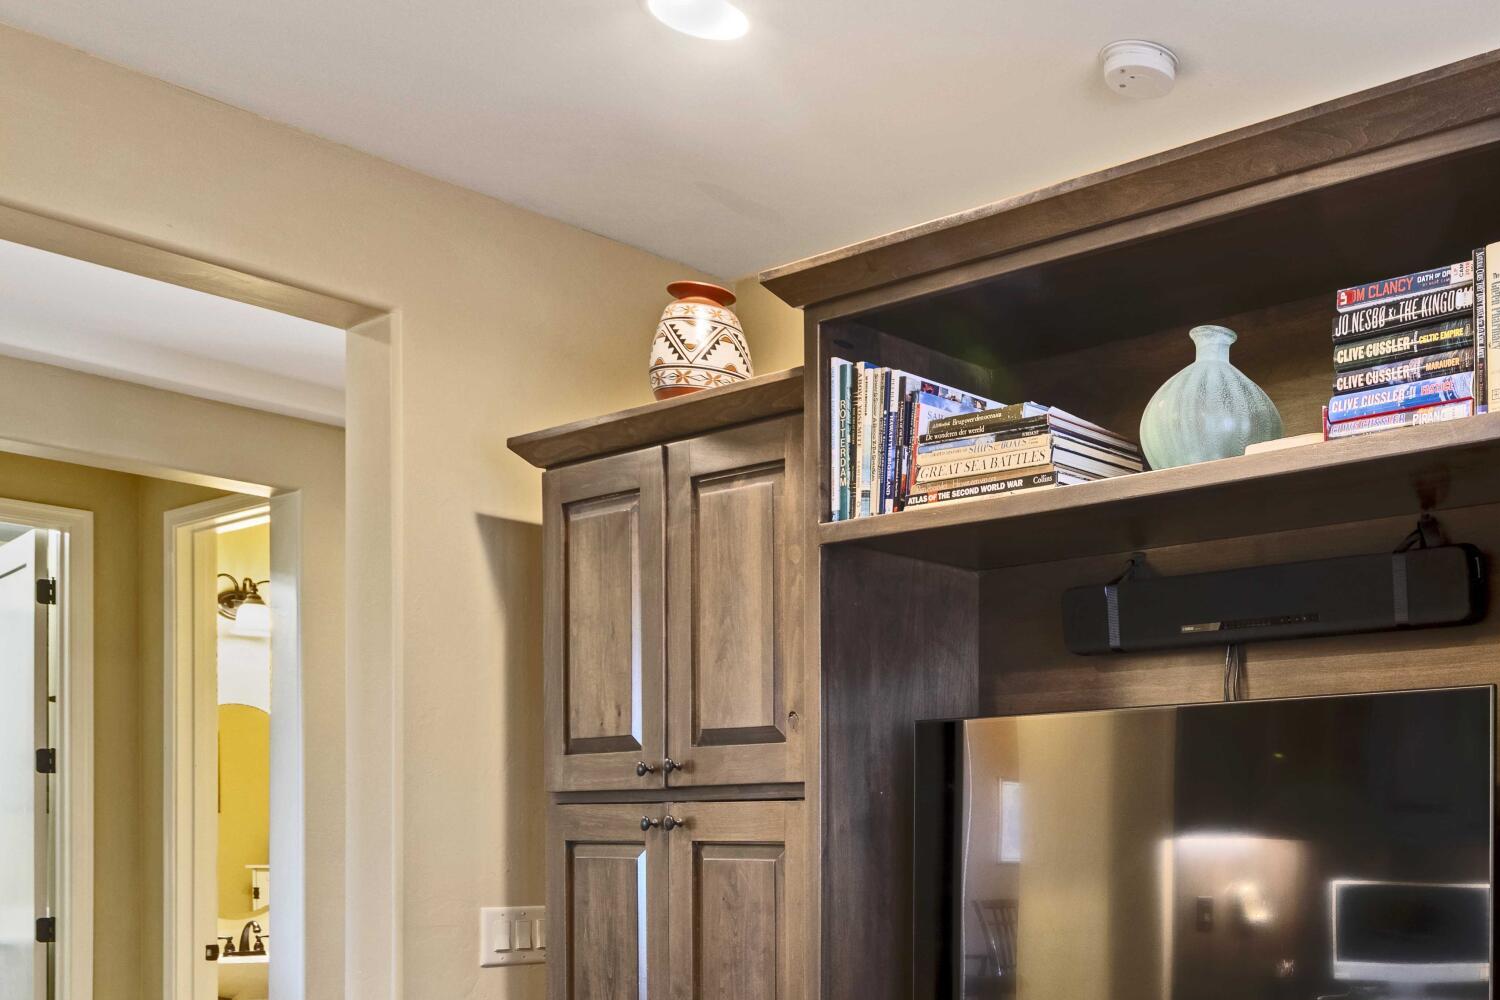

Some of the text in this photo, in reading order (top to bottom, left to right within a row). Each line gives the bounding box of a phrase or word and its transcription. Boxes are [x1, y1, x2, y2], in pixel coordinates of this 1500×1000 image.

[1368, 277, 1414, 298] CLANCY
[1417, 274, 1434, 284] OATH
[1399, 297, 1418, 323] THE
[1335, 313, 1349, 337] JO
[1418, 327, 1464, 344] CELTIC EMPIRE
[1336, 336, 1410, 364] CLIVE CUSSLER
[1425, 357, 1460, 372] MARAUDER
[1336, 364, 1409, 391] CLIVE CUSSLER
[1332, 388, 1405, 413] CLIVE CUSSLER
[934, 430, 957, 439] wonderen
[958, 429, 967, 437] der
[968, 425, 985, 435] wereld
[920, 449, 1046, 480] GREAT SEA BATTLES
[1033, 474, 1053, 485] Collins
[907, 494, 928, 505] ATLAS
[938, 491, 951, 501] THE
[951, 486, 980, 498] SECOND
[980, 482, 1006, 493] WORLD
[1007, 479, 1023, 488] WAR
